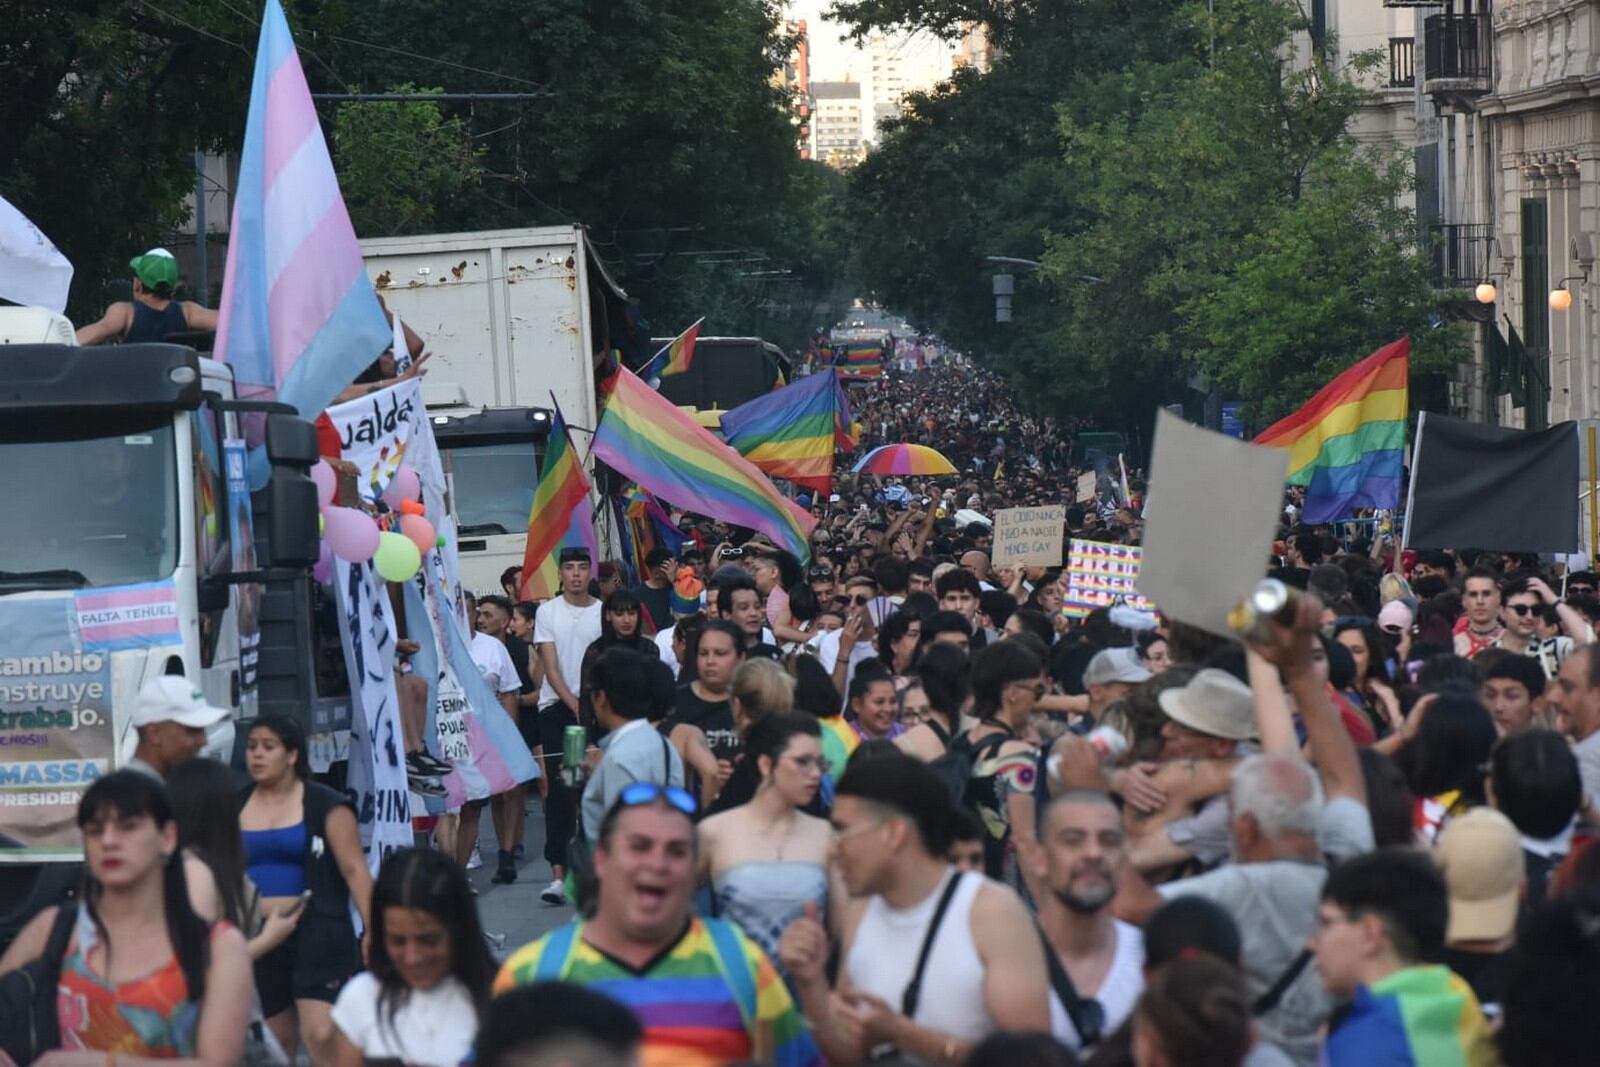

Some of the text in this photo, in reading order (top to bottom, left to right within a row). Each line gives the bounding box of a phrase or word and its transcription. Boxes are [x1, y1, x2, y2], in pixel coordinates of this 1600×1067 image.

[1031, 540, 1051, 552] GAY
[81, 605, 175, 625] FALTA TEHUEL
[0, 649, 103, 675] ambio
[0, 761, 100, 785] MASSA
[0, 791, 81, 807] RESIDEN
